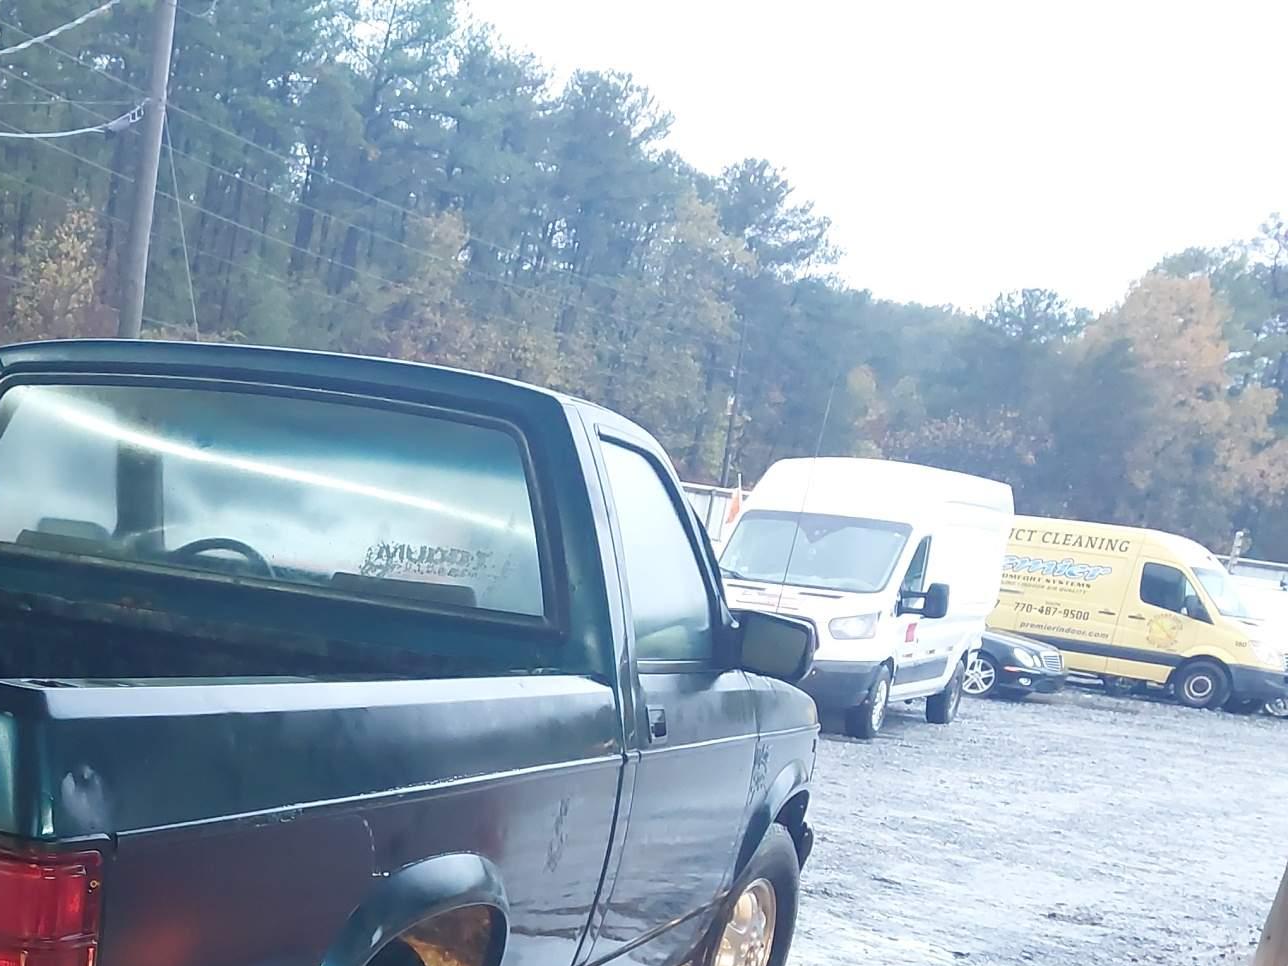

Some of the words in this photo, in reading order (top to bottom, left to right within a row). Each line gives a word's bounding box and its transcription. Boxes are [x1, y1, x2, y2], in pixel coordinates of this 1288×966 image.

[1041, 531, 1131, 553] CLEANING
[1013, 601, 1090, 621] 770-487-9500
[1019, 621, 1110, 639] premierindoor.com
